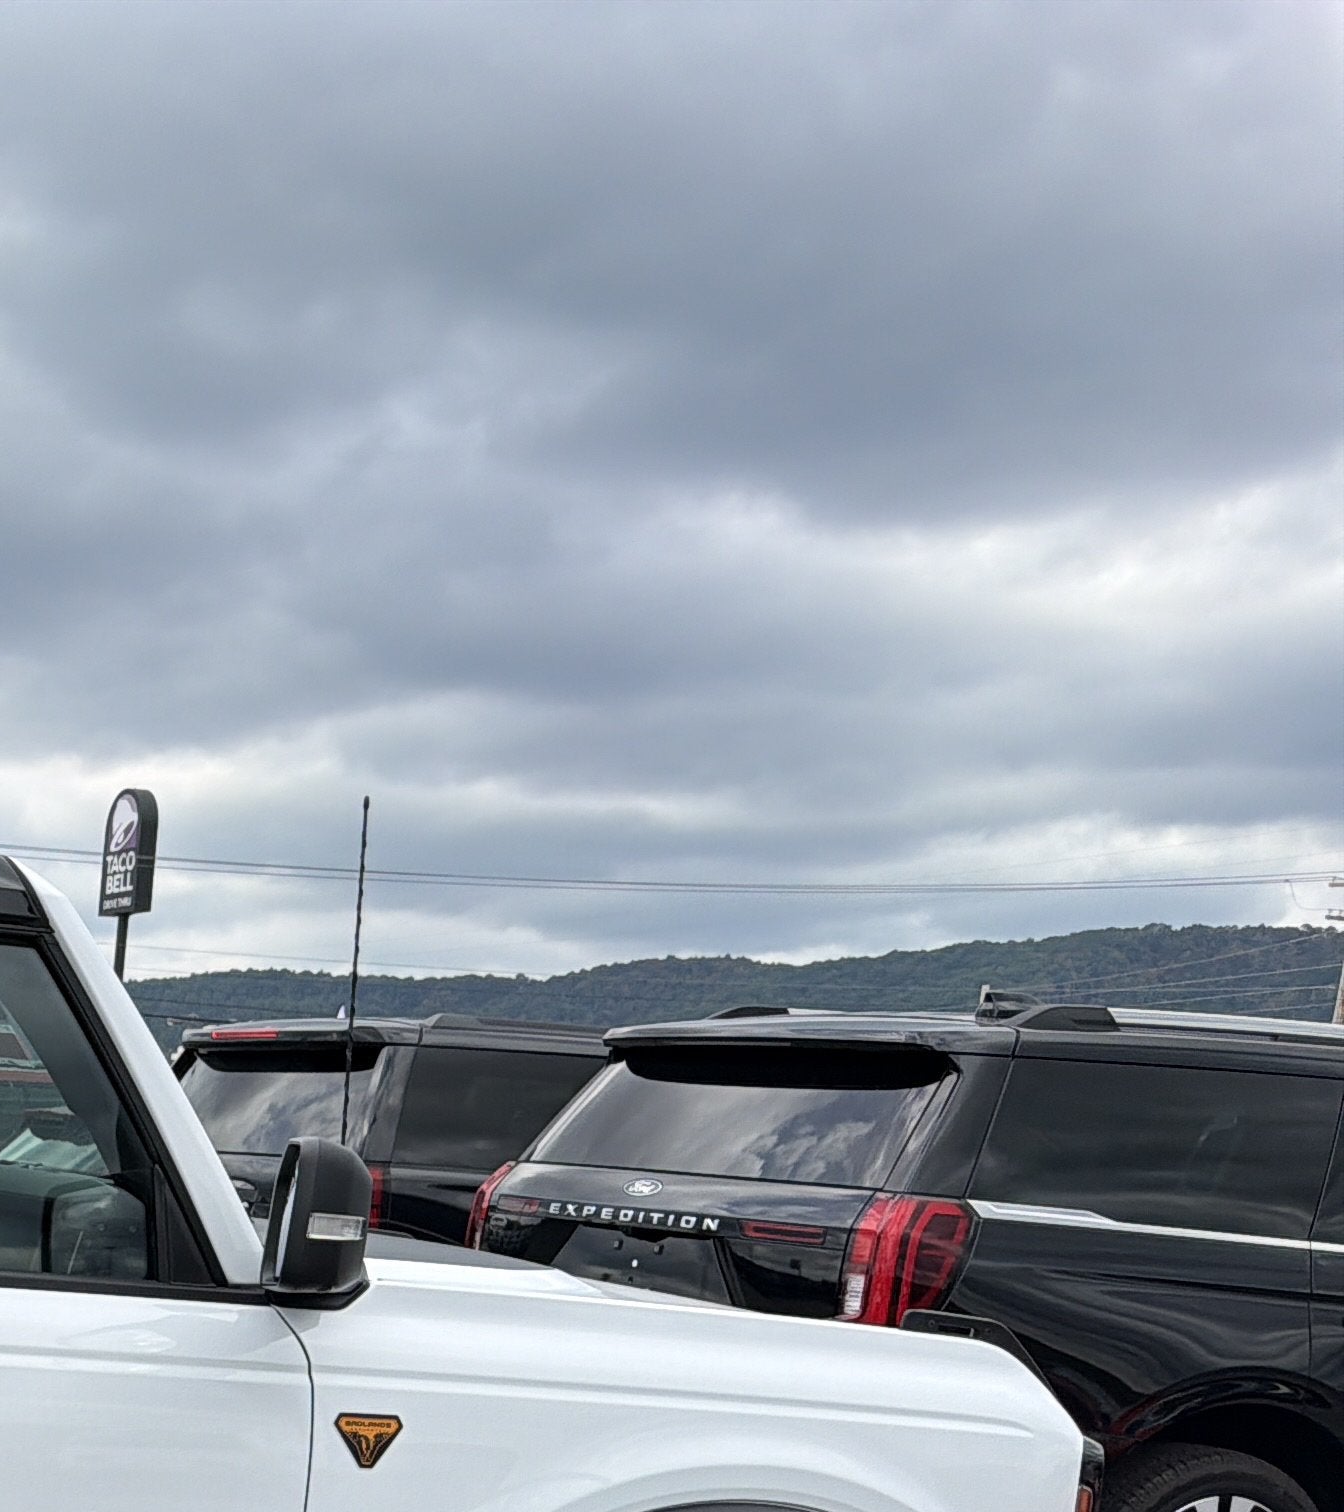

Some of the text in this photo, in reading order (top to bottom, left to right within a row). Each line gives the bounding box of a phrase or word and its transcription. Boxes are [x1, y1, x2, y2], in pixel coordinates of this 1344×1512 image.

[105, 850, 135, 874] TACO
[106, 873, 133, 894] BELL
[548, 1202, 720, 1231] EXPEDITION
[344, 1420, 392, 1429] BADLANDS
